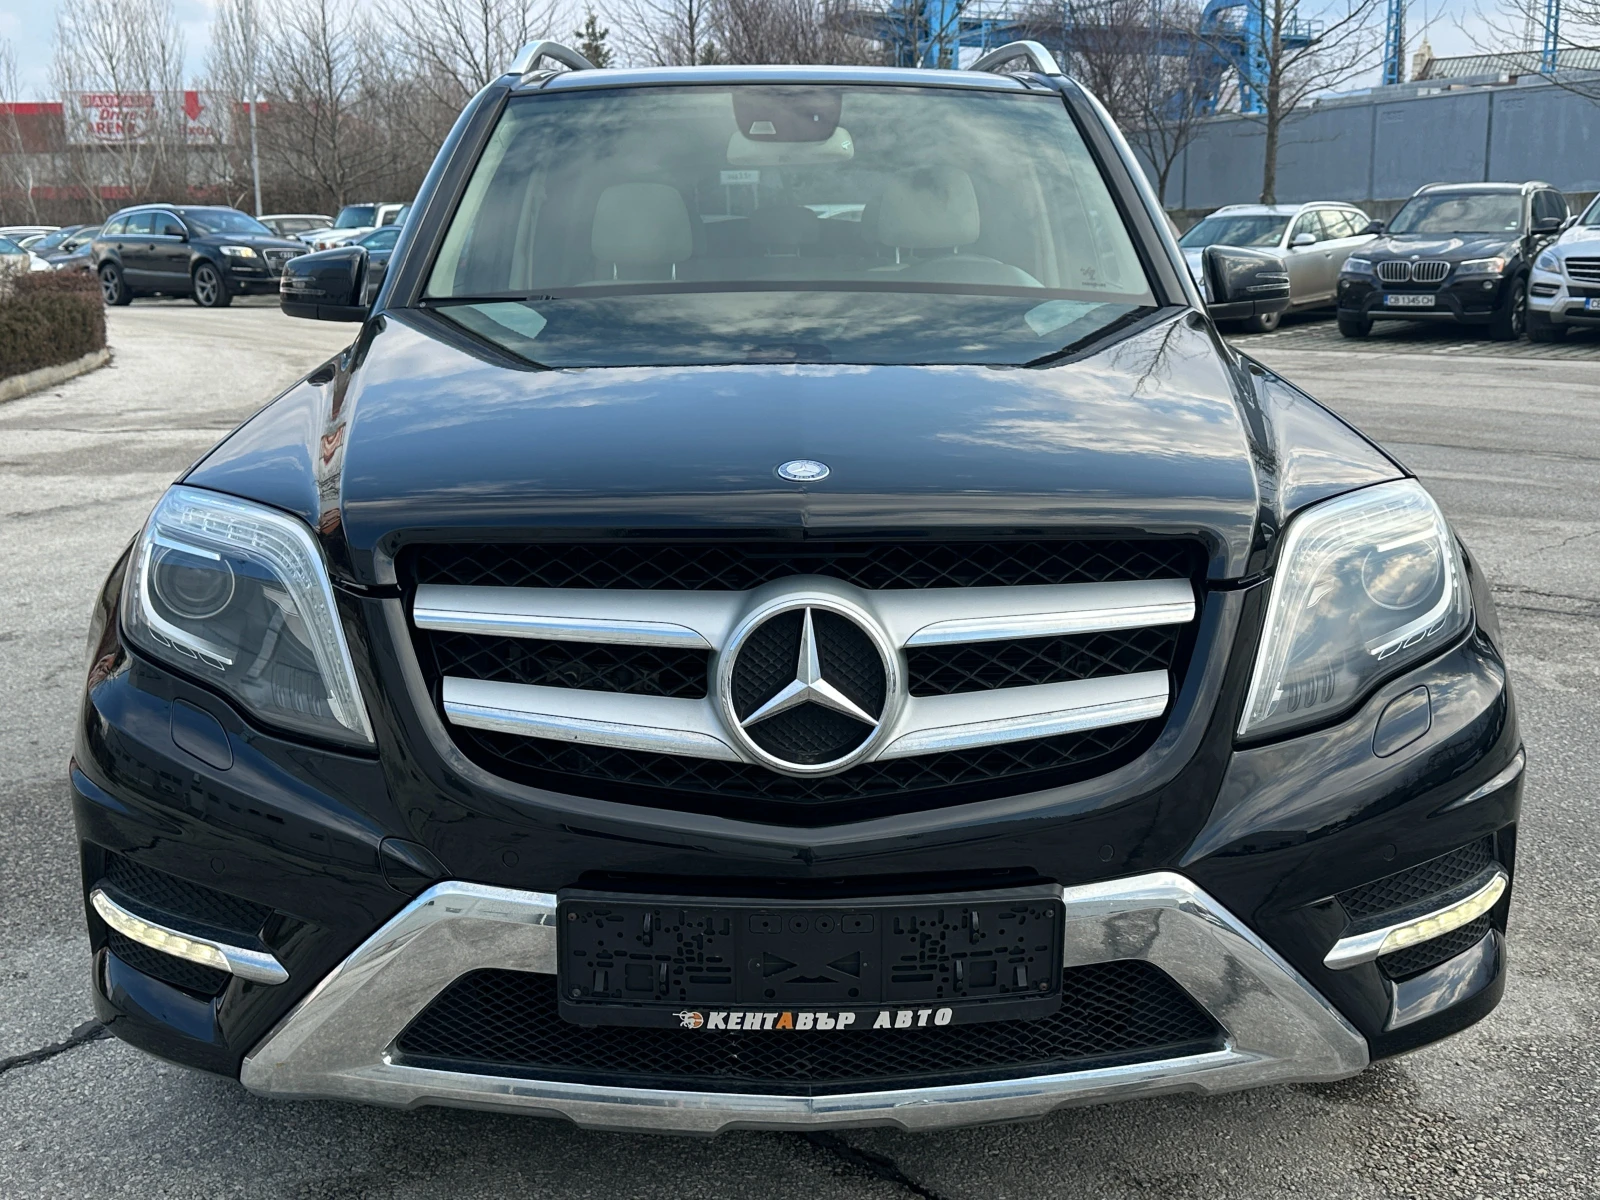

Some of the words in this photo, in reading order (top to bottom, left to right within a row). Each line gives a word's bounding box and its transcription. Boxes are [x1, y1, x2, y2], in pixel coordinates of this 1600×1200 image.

[1402, 296, 1420, 304] 1345
[706, 1011, 856, 1030] КЕНТАВЪР
[873, 1007, 953, 1029] АВТО
